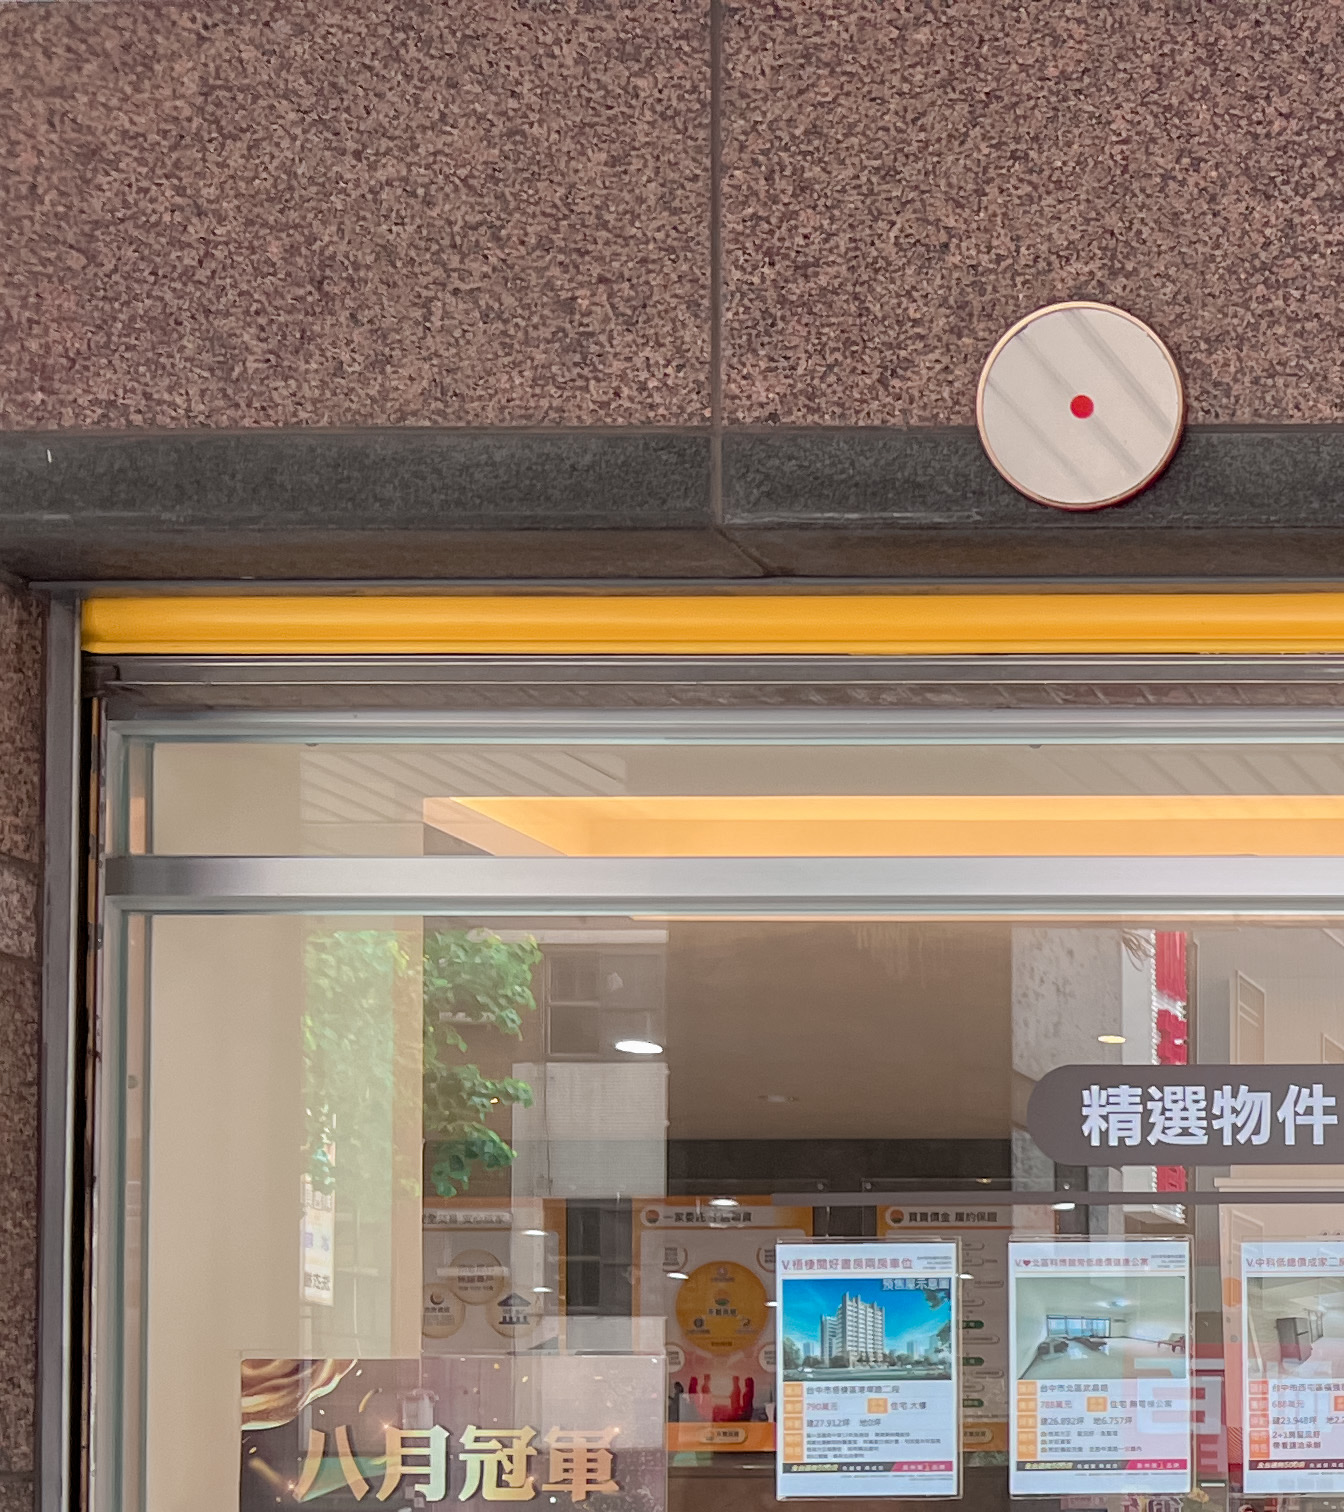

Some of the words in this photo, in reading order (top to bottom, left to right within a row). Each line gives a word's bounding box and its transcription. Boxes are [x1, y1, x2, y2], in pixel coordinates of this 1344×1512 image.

[1080, 1083, 1339, 1148] 精選物件
[294, 1423, 620, 1503] 八月冠軍
